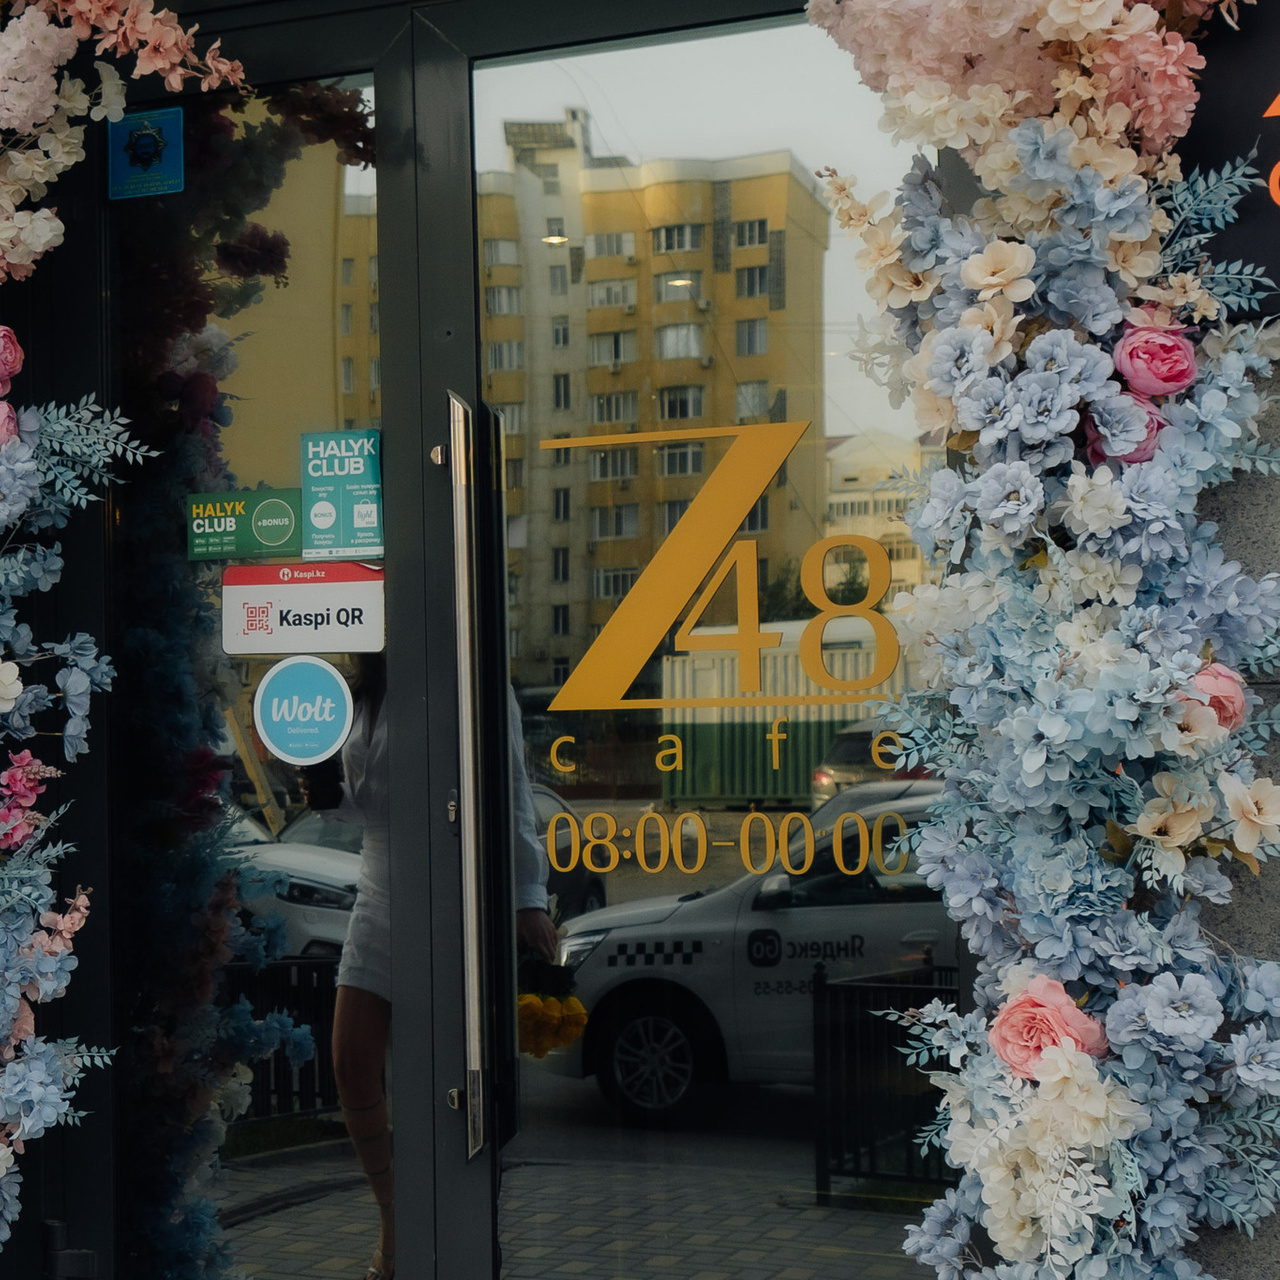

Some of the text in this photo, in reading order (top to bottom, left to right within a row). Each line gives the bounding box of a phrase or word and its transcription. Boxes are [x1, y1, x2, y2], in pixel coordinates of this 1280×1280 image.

[308, 437, 376, 458] HALYK
[308, 457, 365, 477] CLUB
[192, 501, 246, 518] HALYK
[192, 517, 236, 534] CLUB
[257, 517, 290, 527] +BONUS
[293, 569, 326, 580] Kaspi.kz
[539, 420, 903, 711] Z48
[278, 607, 364, 631] Kaspi QR
[271, 695, 336, 722] Wolt
